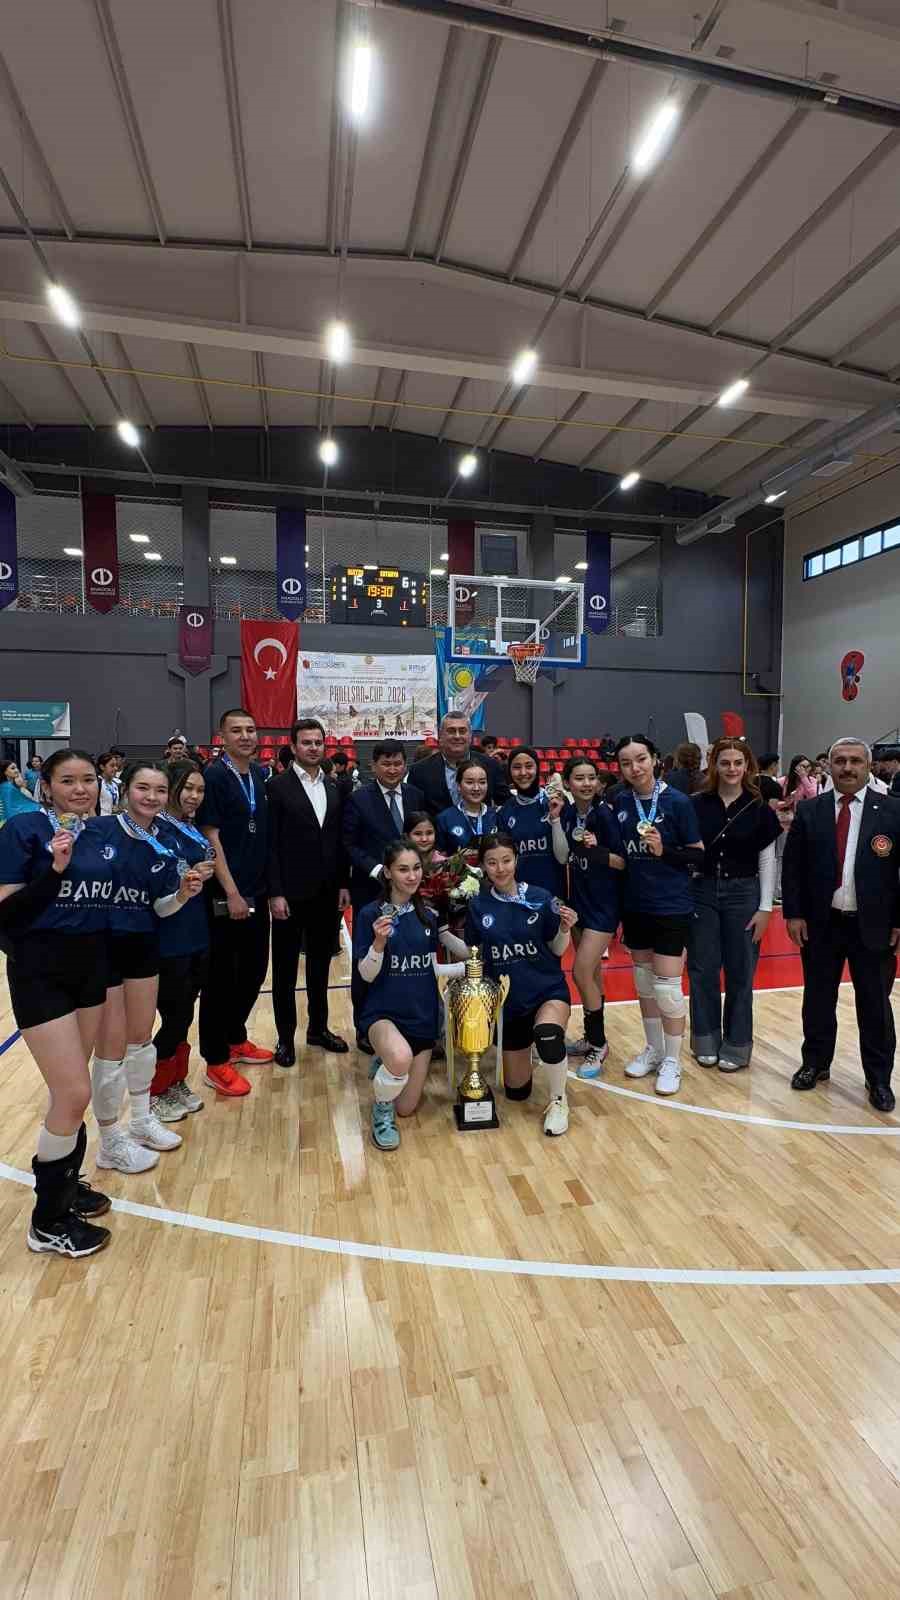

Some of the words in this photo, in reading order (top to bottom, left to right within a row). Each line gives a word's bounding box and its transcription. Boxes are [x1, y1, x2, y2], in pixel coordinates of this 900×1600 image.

[402, 577, 409, 588] 6
[367, 585, 393, 598] 19:30
[376, 599, 382, 609] 3
